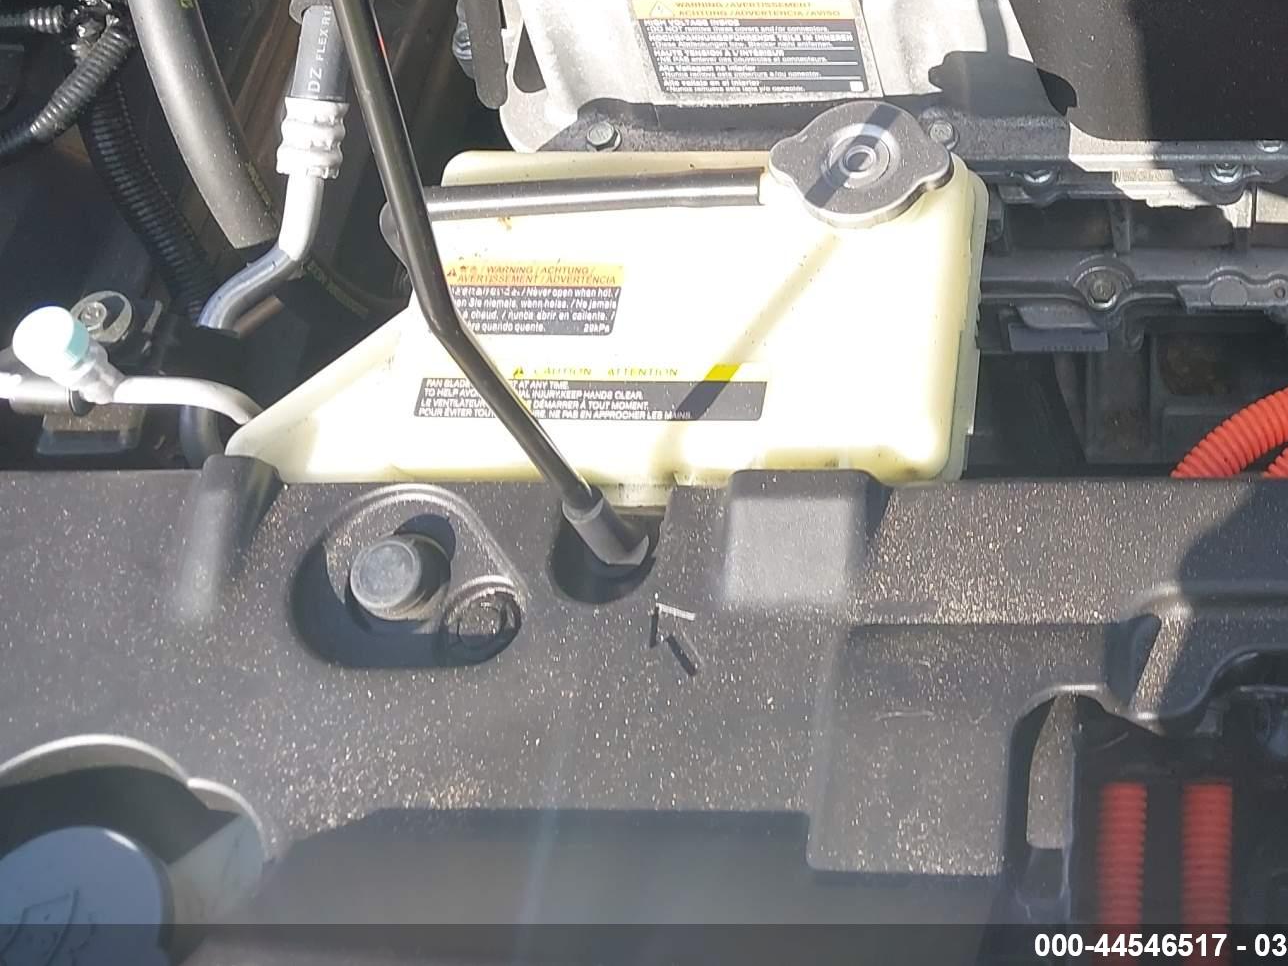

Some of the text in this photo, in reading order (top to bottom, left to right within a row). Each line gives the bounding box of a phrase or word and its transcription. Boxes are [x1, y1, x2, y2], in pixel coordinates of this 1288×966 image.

[315, 27, 329, 62] FLEX
[608, 367, 678, 376] ATTENTION
[460, 388, 482, 397] AVO
